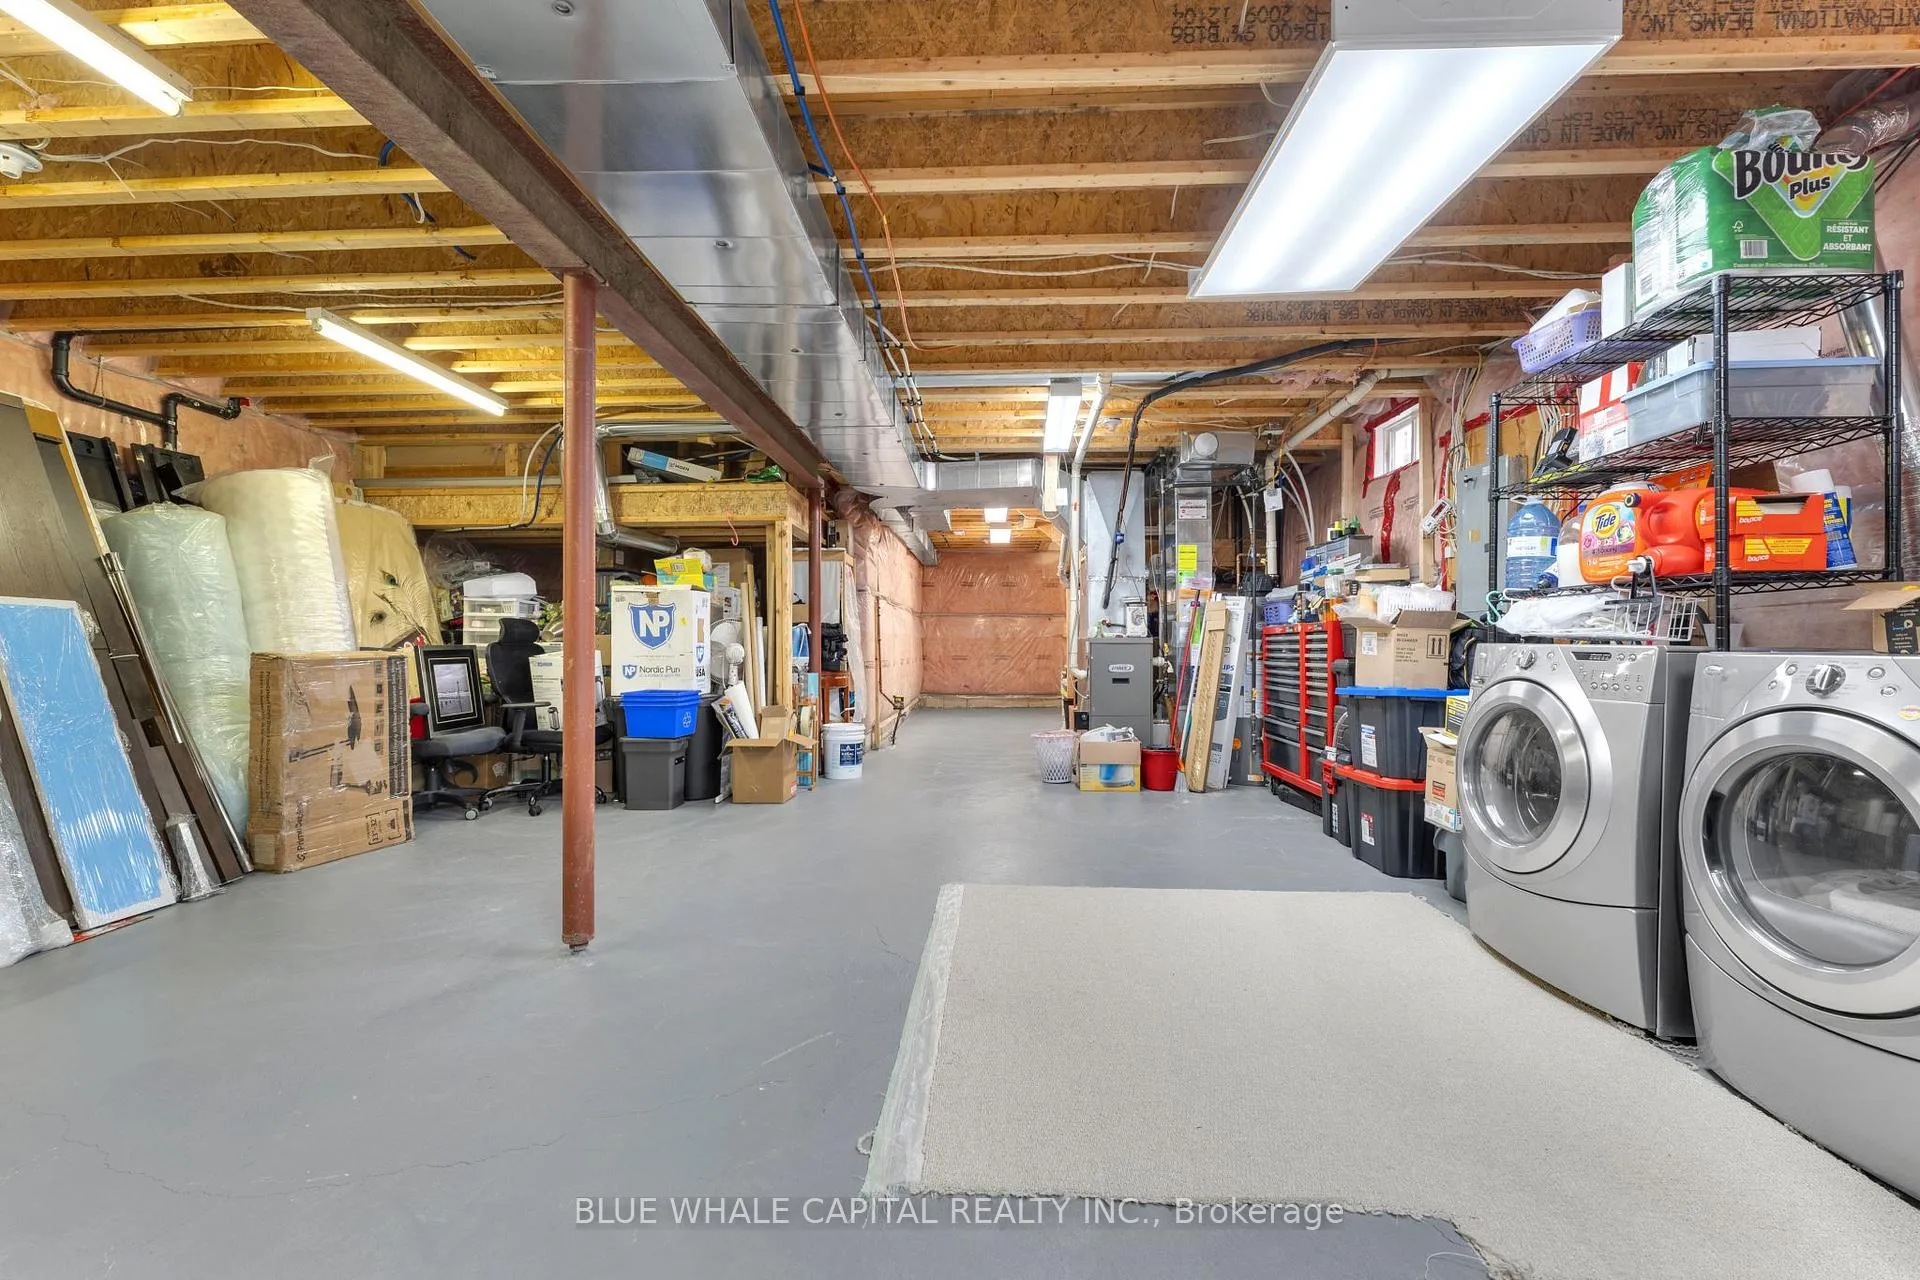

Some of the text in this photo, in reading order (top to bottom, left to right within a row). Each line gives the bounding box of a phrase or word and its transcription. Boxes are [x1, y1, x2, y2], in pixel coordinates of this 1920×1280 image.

[1690, 13, 1754, 32] BEAMS
[1763, 9, 1920, 30] NTERNATIONAL
[1560, 127, 1580, 144] IN
[1590, 126, 1636, 143] MADE
[1696, 123, 1736, 141] AMS
[1788, 175, 1832, 200] Plus
[1826, 224, 1869, 234] RÉSISTANT
[1843, 234, 1853, 242] ET
[1823, 243, 1872, 251] ABSORBANT
[1392, 307, 1433, 319] CANADA
[1595, 513, 1617, 533] Tide
[638, 609, 671, 638] NP
[639, 665, 665, 674] Nordic
